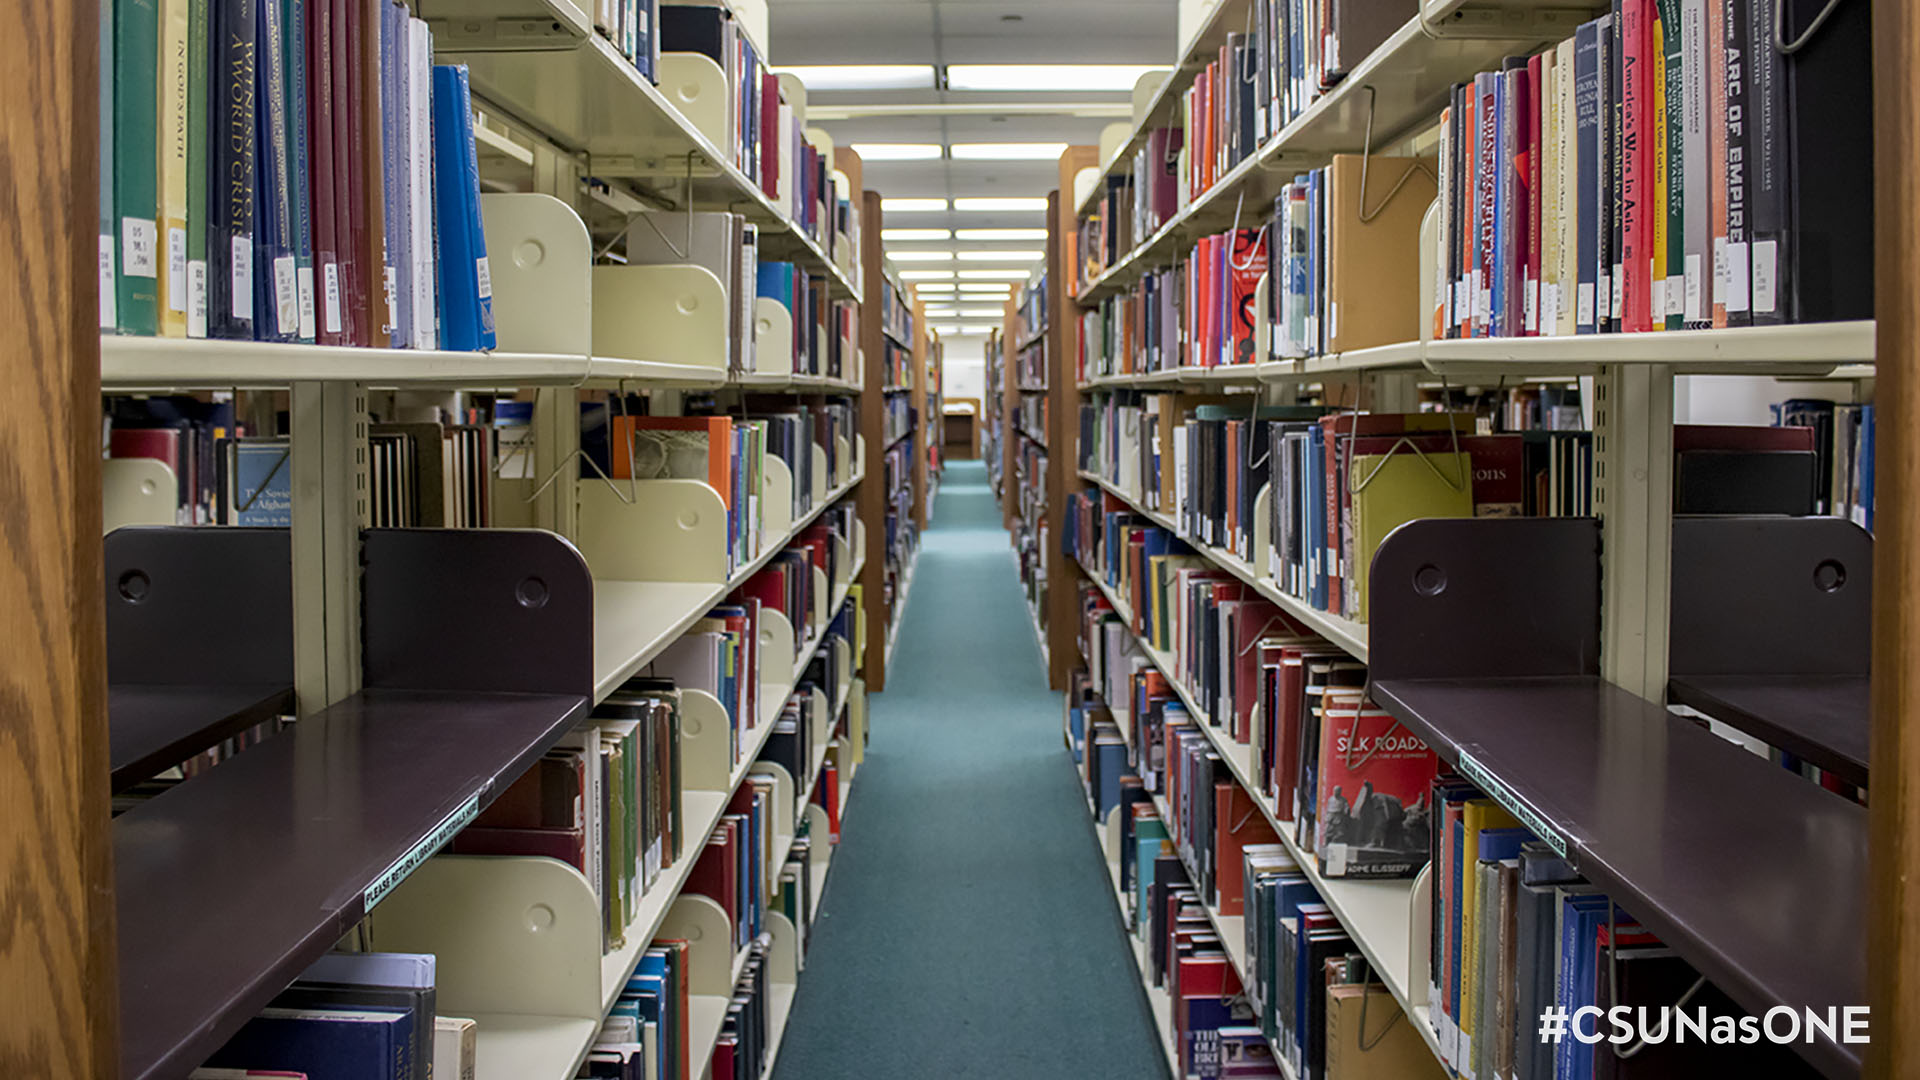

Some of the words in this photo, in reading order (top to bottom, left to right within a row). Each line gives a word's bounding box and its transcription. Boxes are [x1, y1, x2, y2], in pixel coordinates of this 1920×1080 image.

[177, 39, 185, 57] IN
[232, 33, 243, 49] A
[176, 62, 185, 110] GOD'S
[1624, 55, 1636, 130] America's
[1728, 48, 1741, 97] ARC
[231, 60, 244, 154] WORLD
[245, 42, 254, 174] WITNESSES
[1729, 105, 1742, 137] OF
[176, 112, 185, 159] PATH
[1614, 103, 1623, 178] Leadership
[1625, 131, 1636, 173] Wars
[245, 187, 253, 218] TO
[1484, 162, 1495, 247] SECURITY
[1614, 179, 1622, 194] in
[1625, 179, 1635, 194] in
[1671, 154, 1679, 216] STABILITY
[1730, 147, 1743, 243] EMPIRE
[1614, 198, 1622, 229] Asia
[1624, 199, 1636, 233] Asia
[1484, 248, 1494, 265] IN
[1374, 736, 1429, 751] ROADS
[365, 876, 390, 906] PLEASE
[391, 859, 414, 885] RETURN
[414, 836, 439, 863] LIBRARY
[438, 811, 466, 841] MATERIALS
